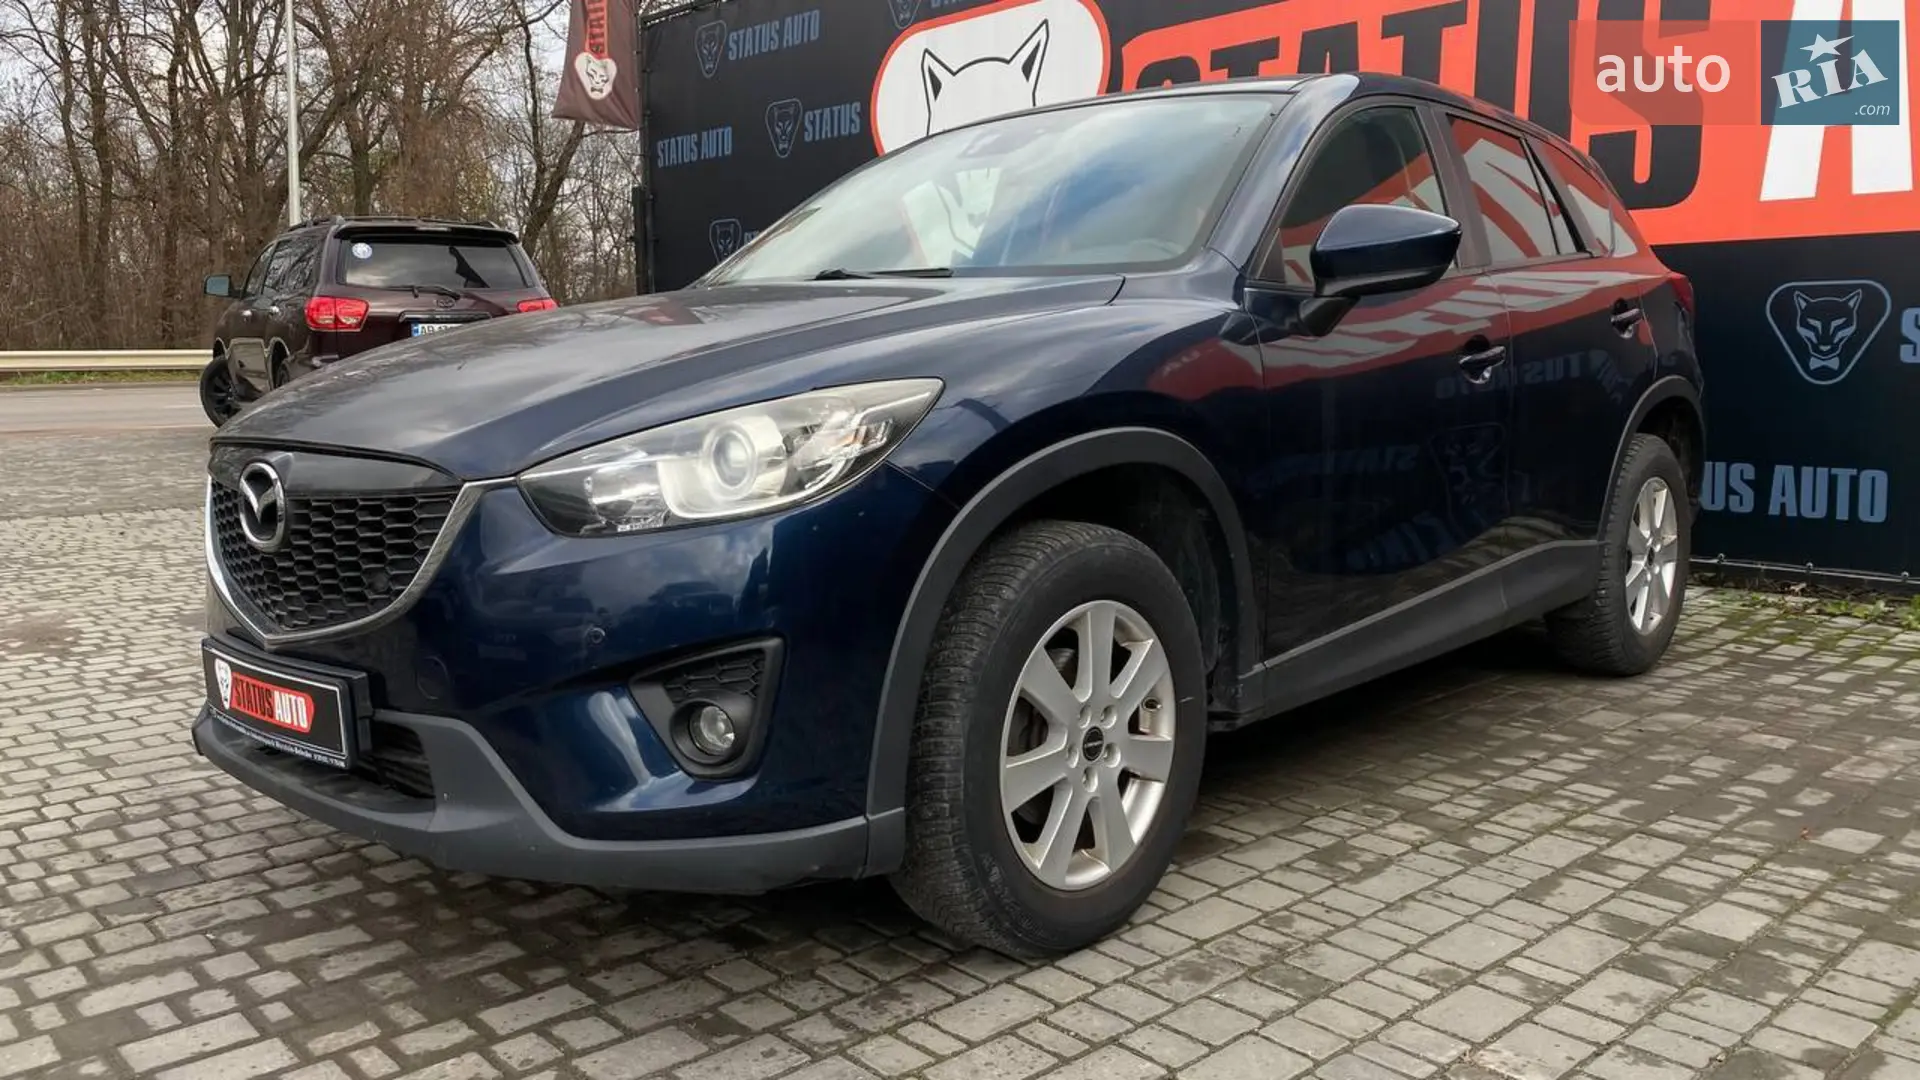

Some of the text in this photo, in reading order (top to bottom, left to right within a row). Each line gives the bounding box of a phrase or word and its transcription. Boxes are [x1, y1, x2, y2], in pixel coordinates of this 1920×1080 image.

[728, 9, 820, 61] STATUS AUTO
[656, 126, 733, 168] STATUS AUTO
[804, 101, 861, 142] STATUS
[1768, 464, 1889, 524] AUTO
[234, 677, 308, 729] STATUS AUTO
